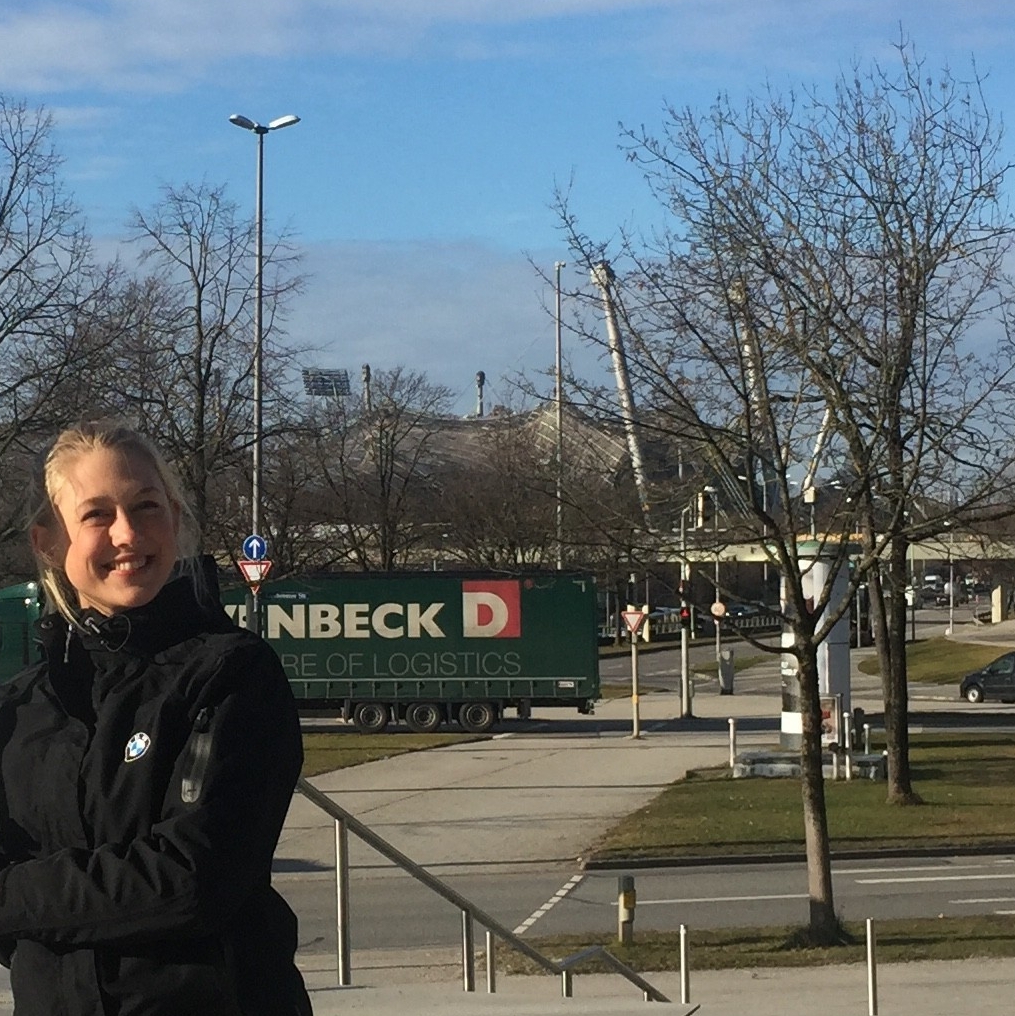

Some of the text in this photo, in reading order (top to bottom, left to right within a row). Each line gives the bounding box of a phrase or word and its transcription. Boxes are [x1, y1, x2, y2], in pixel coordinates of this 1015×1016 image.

[224, 592, 509, 638] NBECK D
[281, 652, 522, 676] RE OF LOGISTICS
